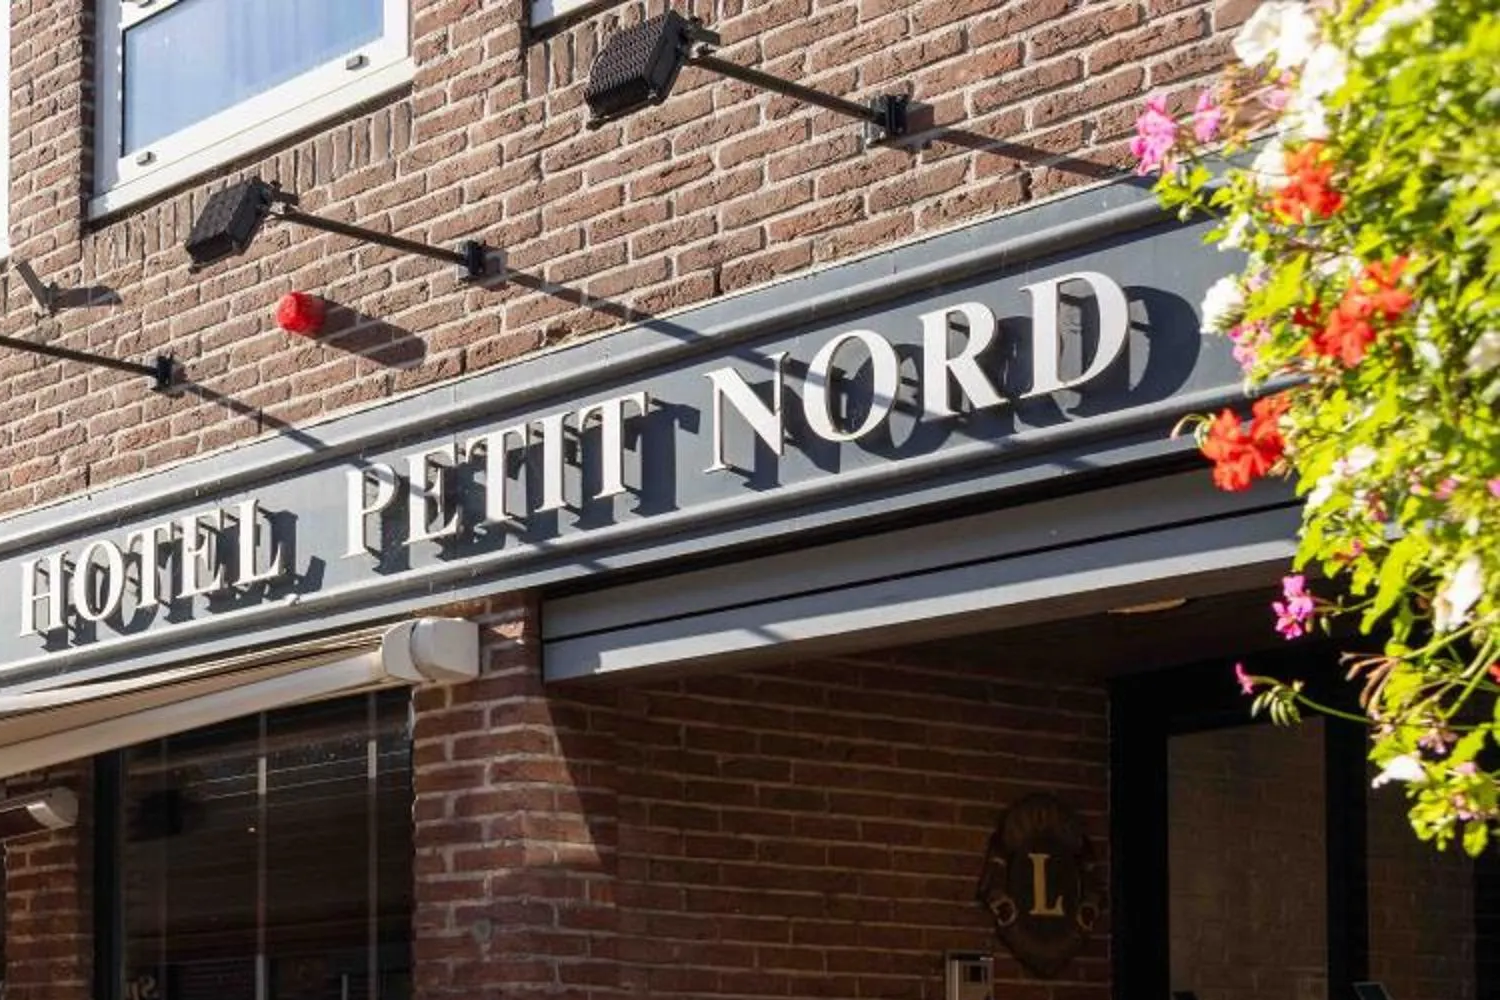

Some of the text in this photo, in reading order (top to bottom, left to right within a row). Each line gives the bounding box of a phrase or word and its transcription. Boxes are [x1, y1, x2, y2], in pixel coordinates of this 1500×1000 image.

[20, 271, 1130, 638] HOTEL PETIT NORD
[1027, 853, 1065, 916] L
